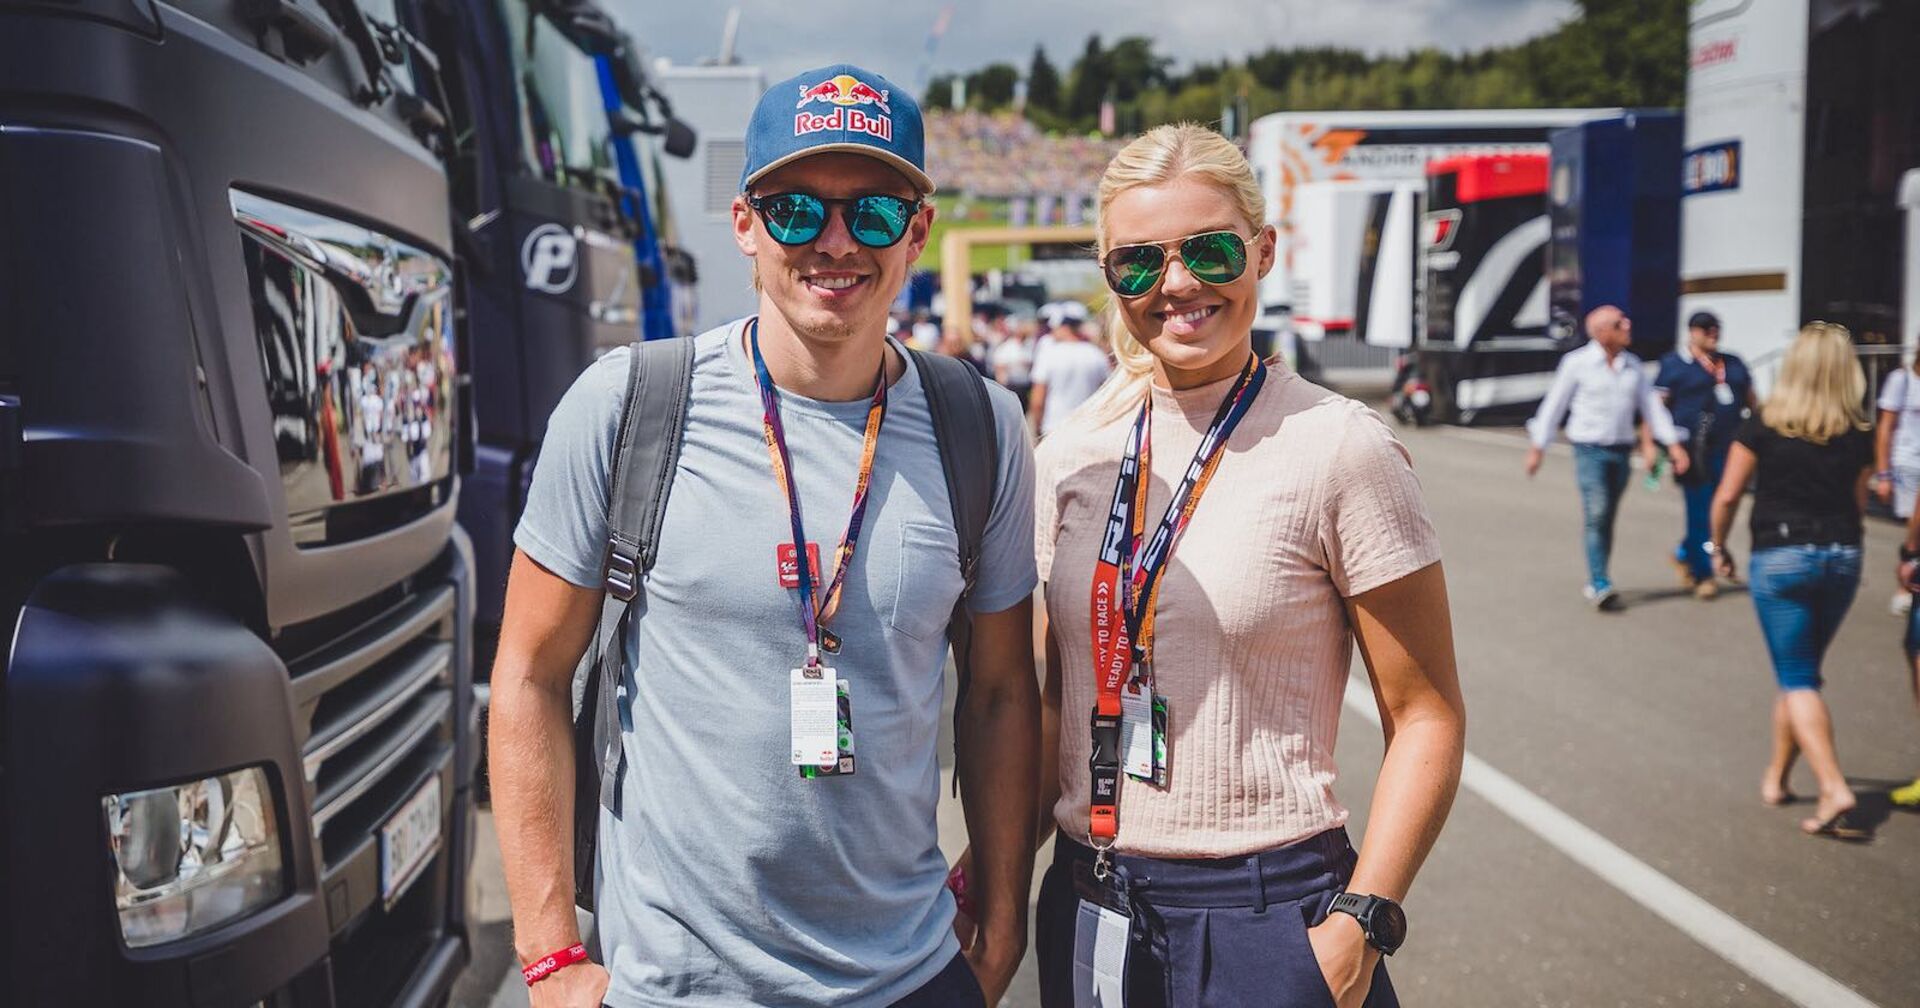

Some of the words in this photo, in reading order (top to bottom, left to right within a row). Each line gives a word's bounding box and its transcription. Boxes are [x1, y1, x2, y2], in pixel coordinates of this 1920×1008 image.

[795, 107, 844, 136] Red
[847, 109, 892, 142] Bull
[1097, 597, 1109, 627] RACE
[1098, 630, 1110, 645] TO
[1107, 653, 1124, 688] READY
[1116, 635, 1129, 650] TO
[523, 957, 557, 981] ONNTAG
